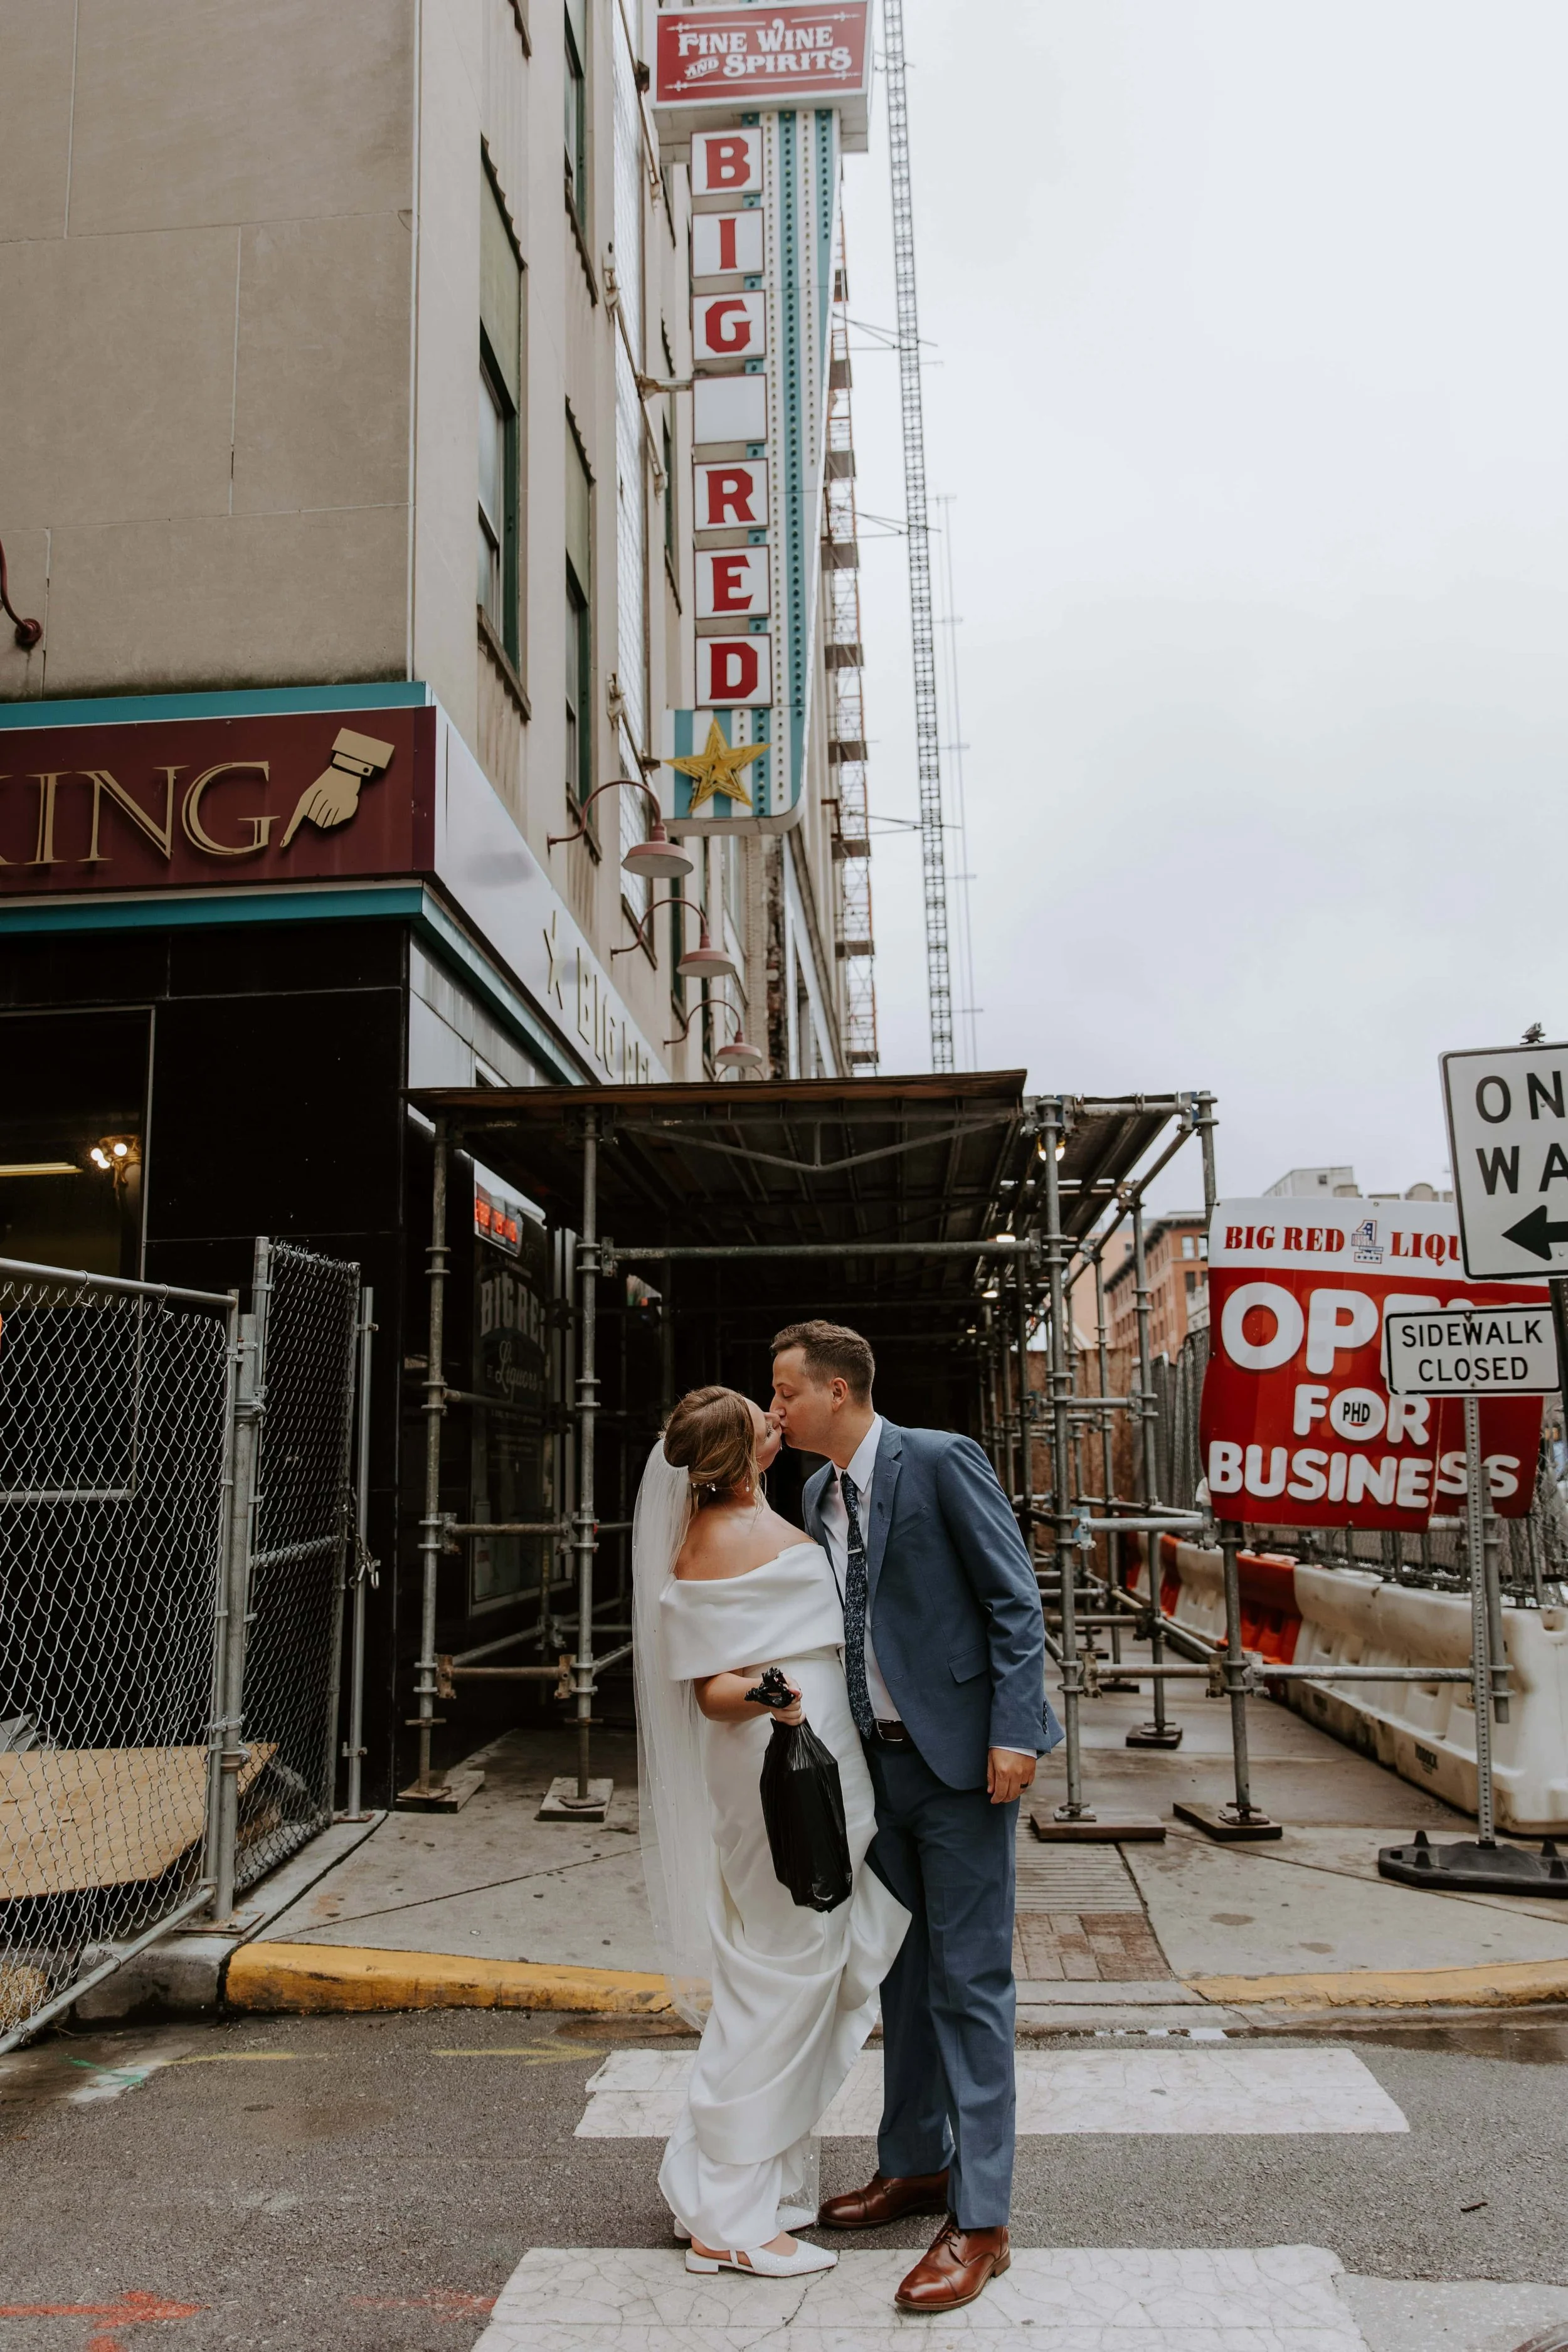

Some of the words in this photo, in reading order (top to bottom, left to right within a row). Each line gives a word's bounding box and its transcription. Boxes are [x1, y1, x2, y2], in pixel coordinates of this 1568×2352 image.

[678, 32, 748, 56] FINE
[756, 18, 834, 53] WINE
[685, 57, 720, 77] AND
[723, 46, 852, 77] SPIRITS
[706, 137, 751, 352] BIG
[706, 468, 758, 700] RED
[0, 760, 281, 866] ING
[1476, 1071, 1565, 1123] ON
[1475, 1143, 1568, 1195] WA
[1224, 1226, 1274, 1249] BIG
[1283, 1227, 1345, 1253] RED
[480, 1271, 514, 1337] BIG
[1221, 1281, 1475, 1375] OP
[1401, 1320, 1543, 1348] SIDEWALK
[1418, 1357, 1528, 1382] CLOSED
[1293, 1384, 1431, 1445] FOR
[1343, 1402, 1370, 1422] PHD
[1208, 1441, 1520, 1508] BUSINESS
